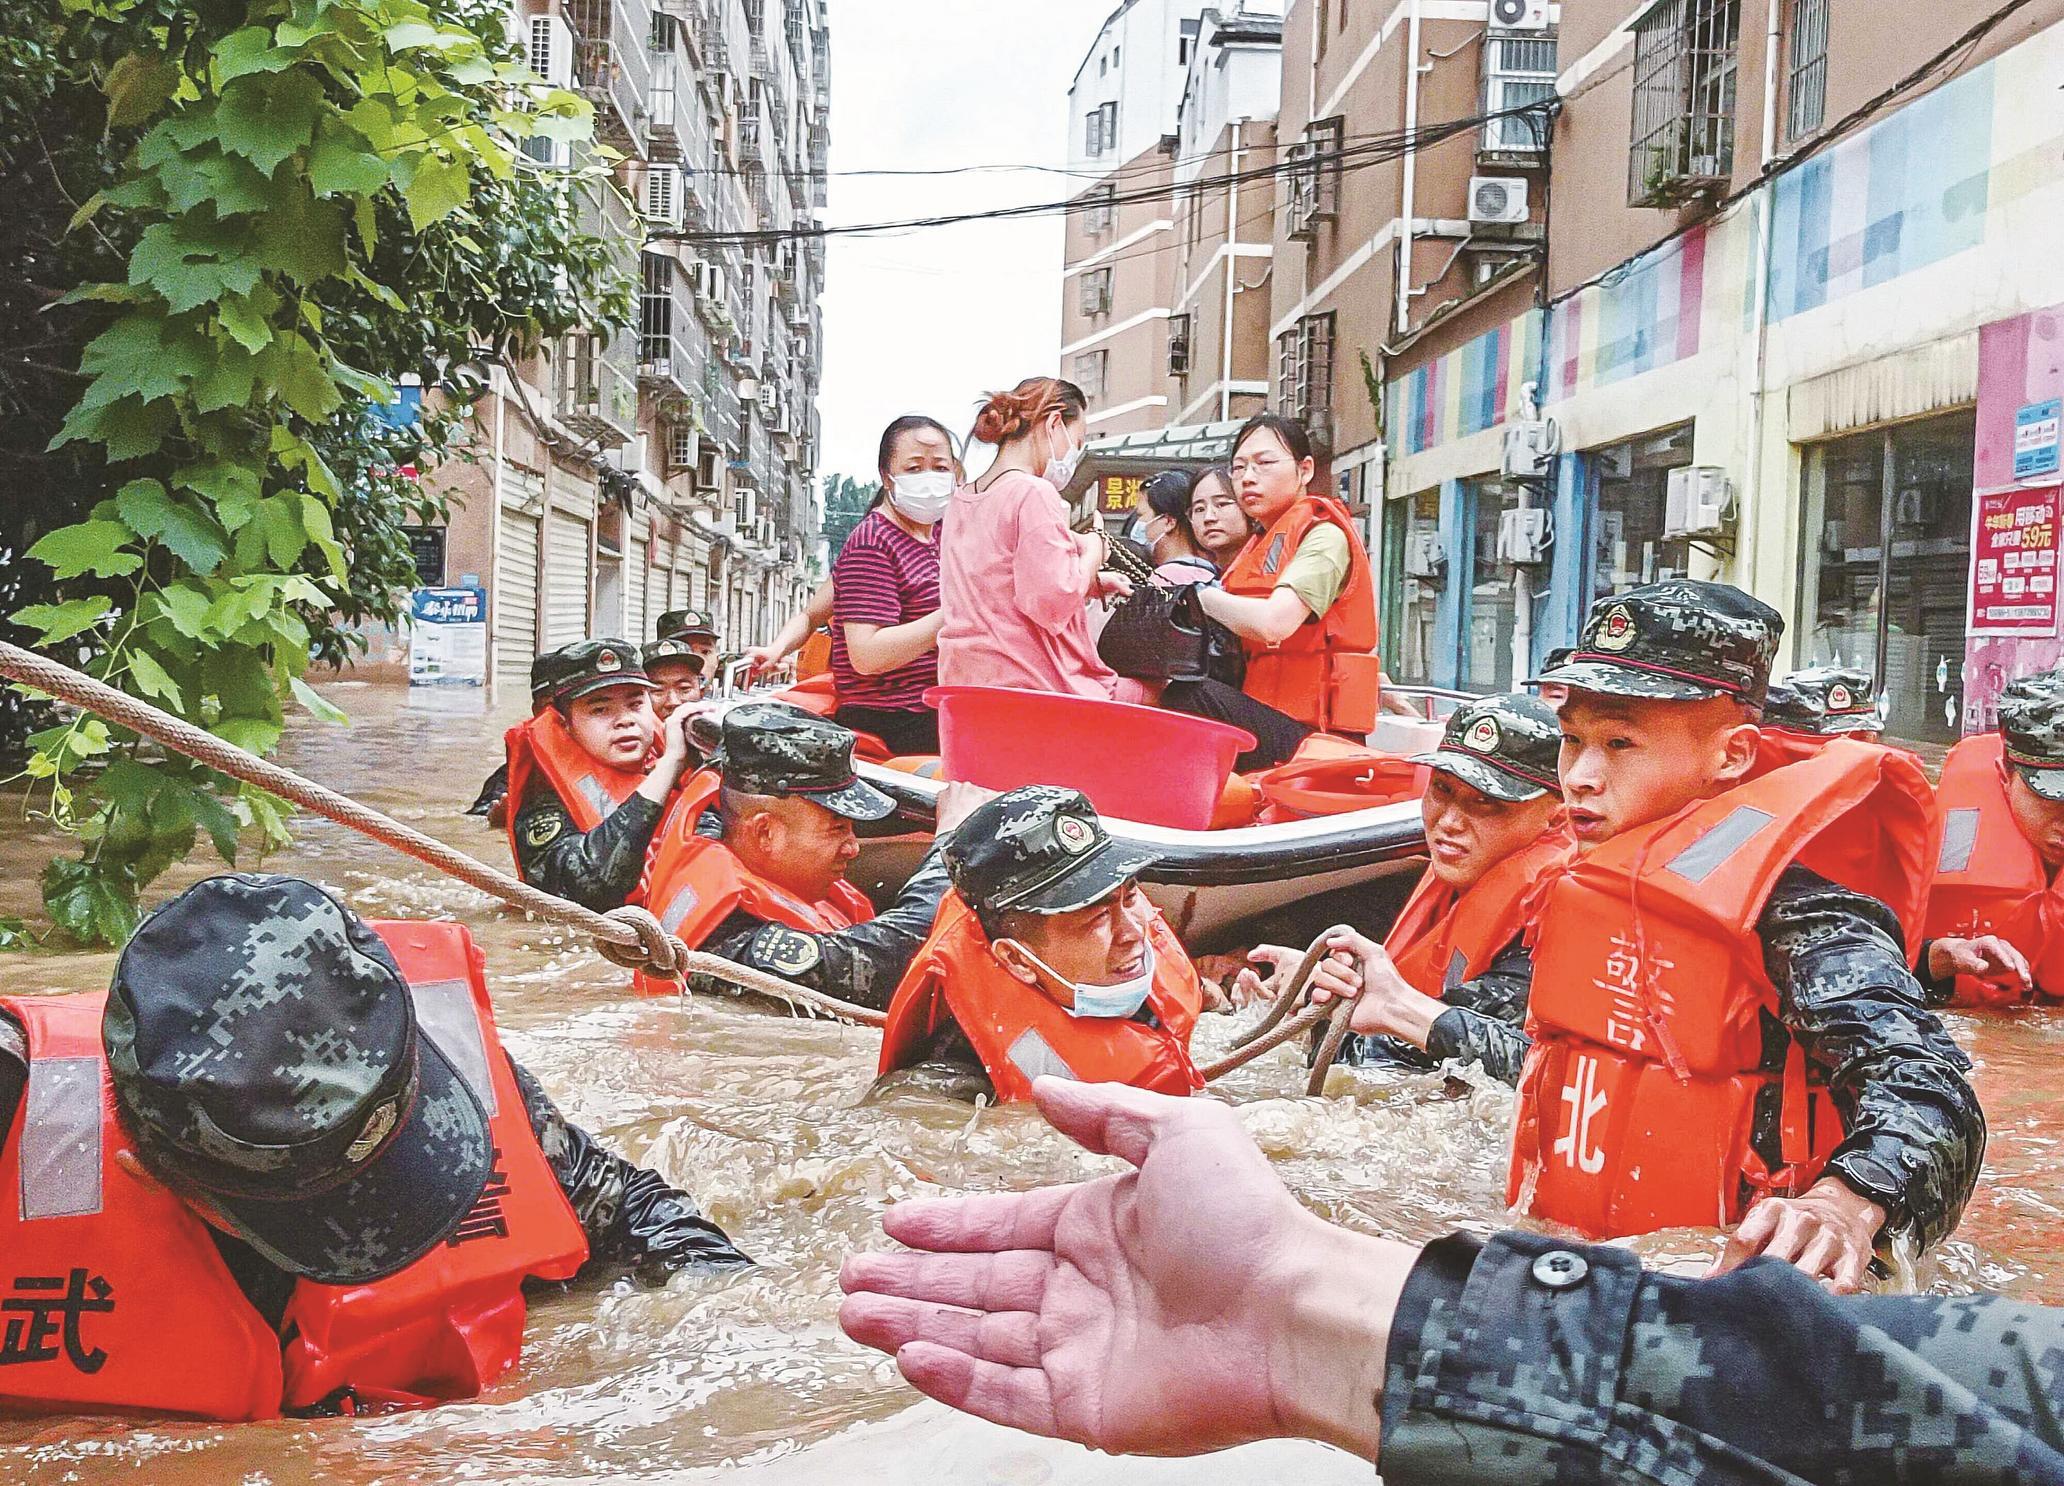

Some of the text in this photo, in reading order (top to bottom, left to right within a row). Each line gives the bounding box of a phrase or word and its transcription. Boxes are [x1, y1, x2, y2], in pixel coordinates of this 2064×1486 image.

[1591, 928, 1676, 1051] 警
[1553, 1055, 1608, 1175] 北
[0, 1267, 116, 1375] 武
